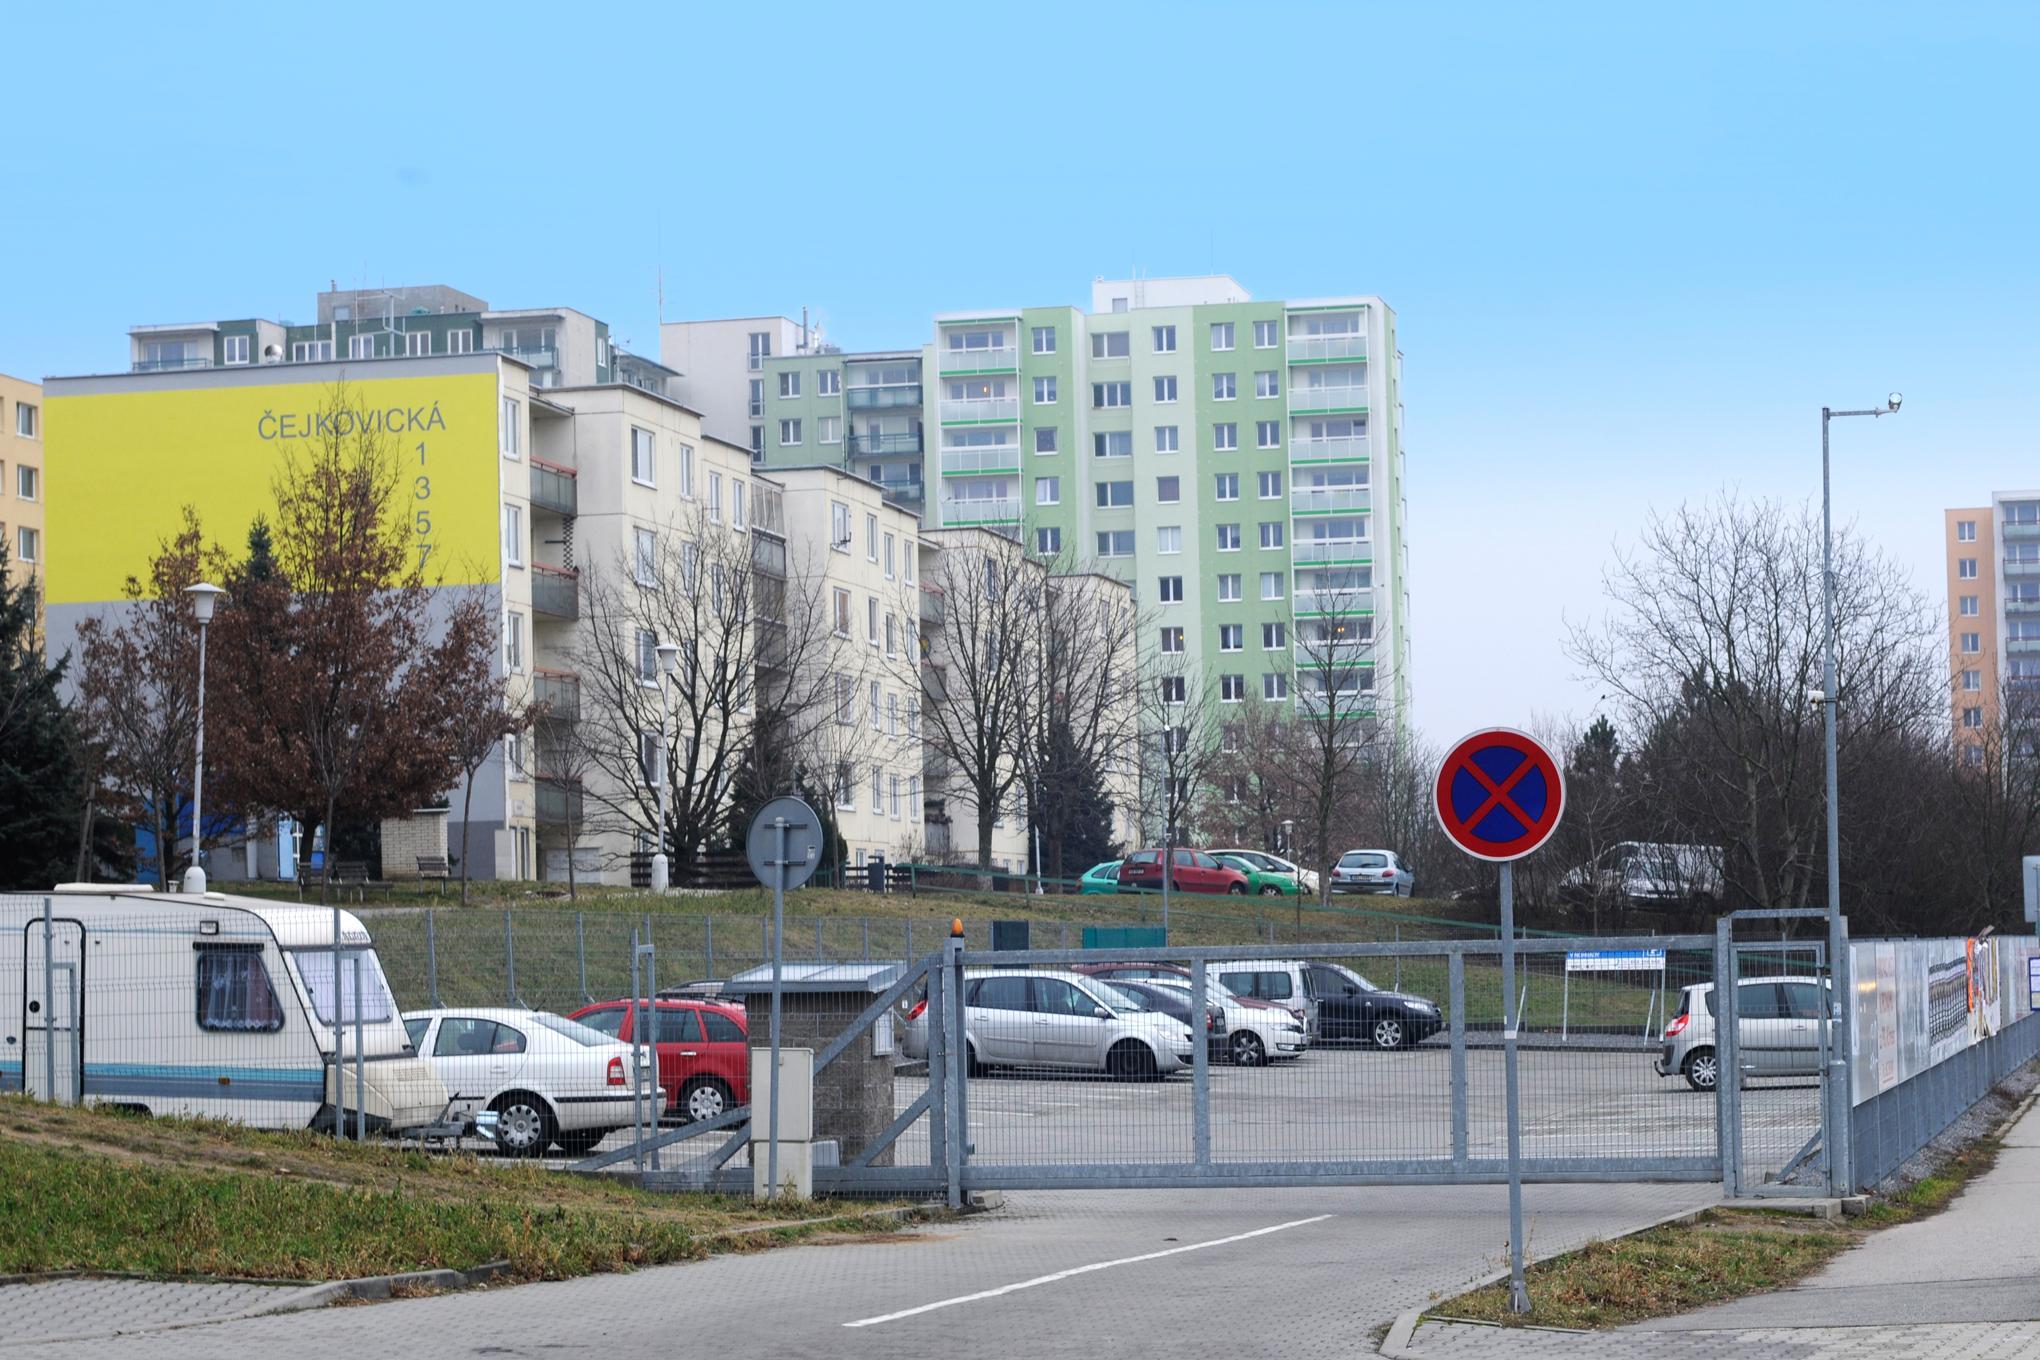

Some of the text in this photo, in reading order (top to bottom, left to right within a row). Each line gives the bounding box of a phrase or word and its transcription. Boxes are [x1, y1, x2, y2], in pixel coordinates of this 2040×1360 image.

[257, 401, 446, 440] ČEJKOVICKÁ
[415, 441, 426, 466] 1
[415, 476, 431, 500] 3
[415, 510, 432, 535] 5
[415, 544, 432, 569] 7
